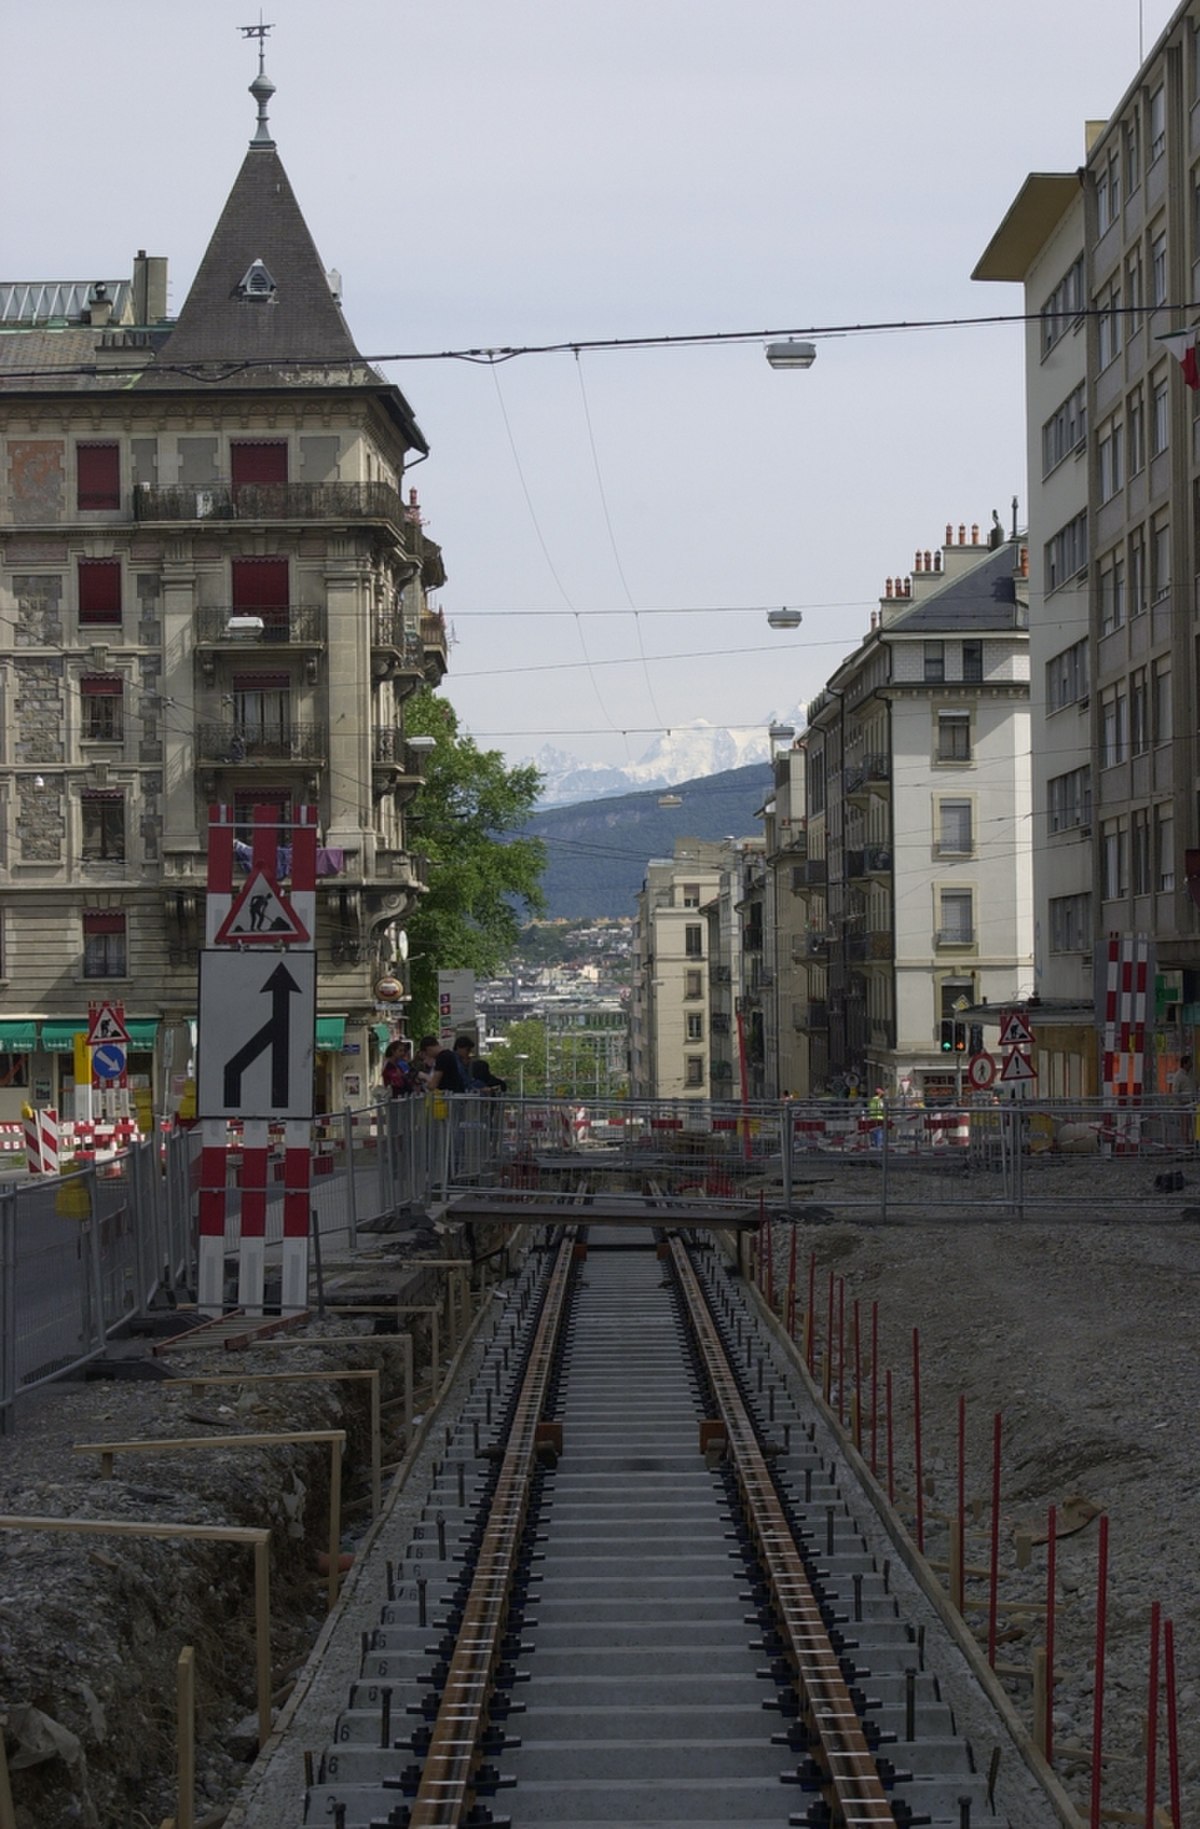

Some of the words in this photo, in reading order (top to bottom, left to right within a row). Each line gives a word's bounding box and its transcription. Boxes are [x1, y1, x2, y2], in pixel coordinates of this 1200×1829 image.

[415, 1547, 424, 1559] 6
[378, 1633, 386, 1649] 6
[378, 1660, 388, 1676] 6
[340, 1724, 350, 1742] 6
[328, 1756, 338, 1774] 6
